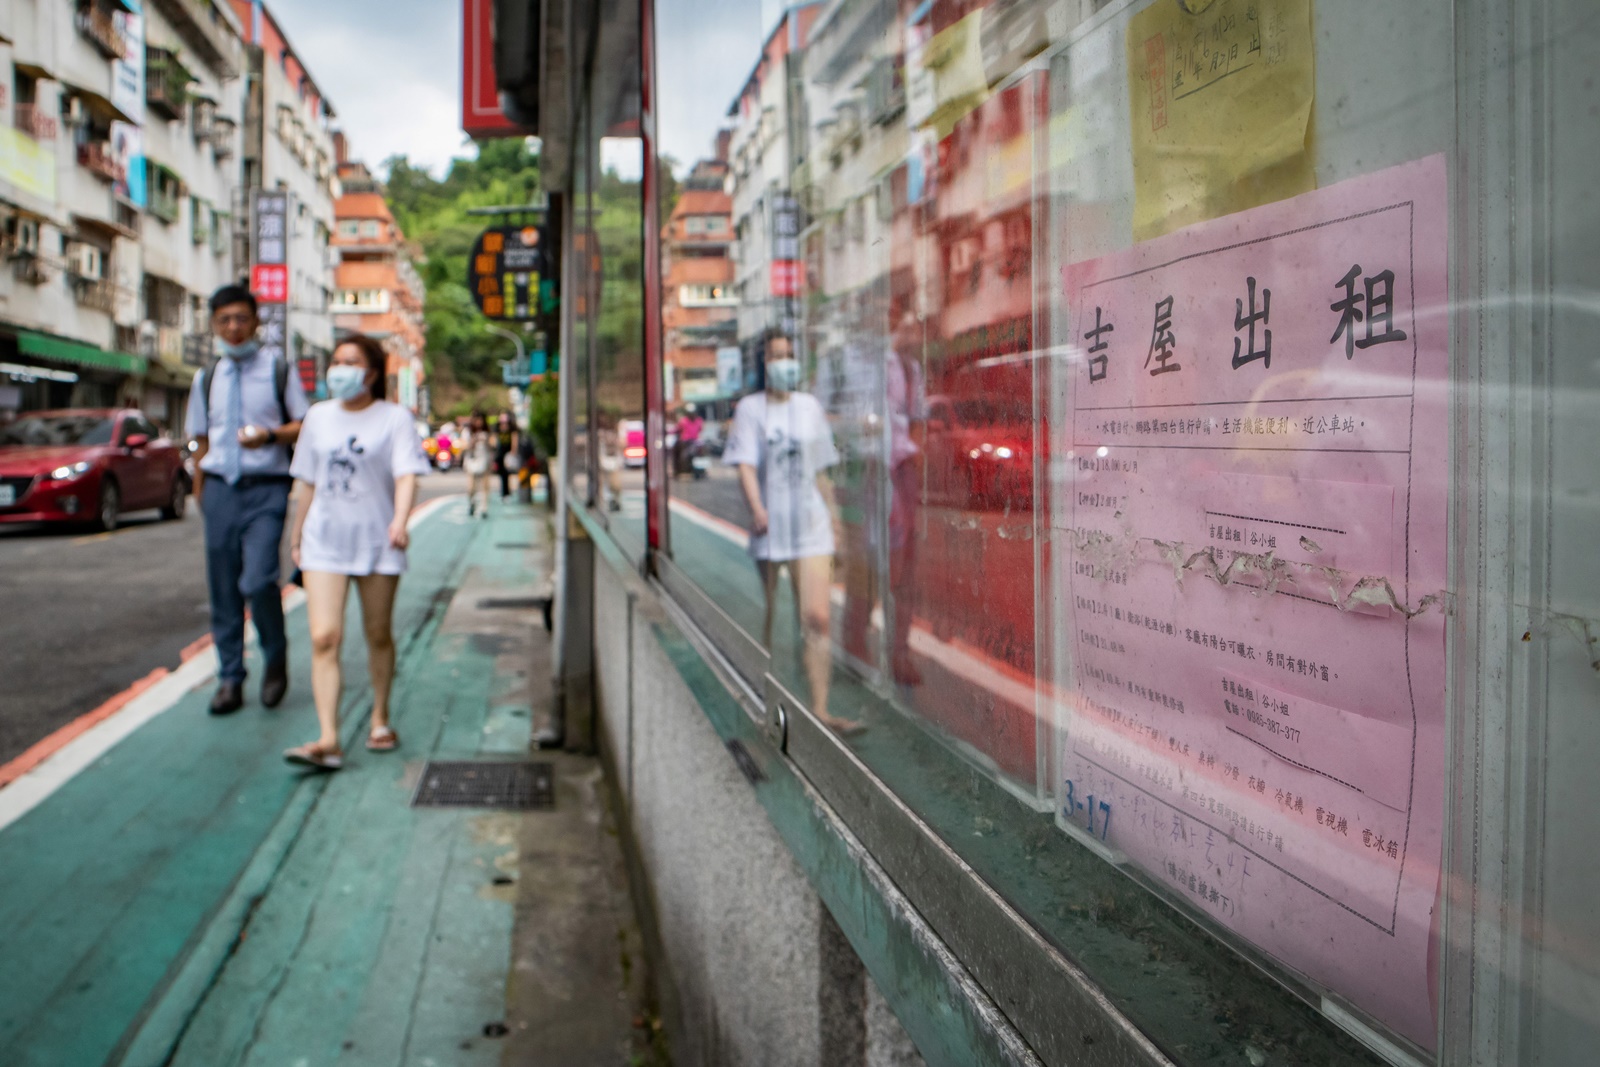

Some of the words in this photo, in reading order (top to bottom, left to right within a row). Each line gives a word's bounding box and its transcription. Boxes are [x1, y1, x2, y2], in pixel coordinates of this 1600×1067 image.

[1084, 263, 1408, 385] 吉屋出租
[1223, 761, 1241, 782] 沙發
[1274, 786, 1305, 816] 冷氣機
[1315, 806, 1349, 838] 電視機
[1361, 827, 1399, 861] 電冰箱
